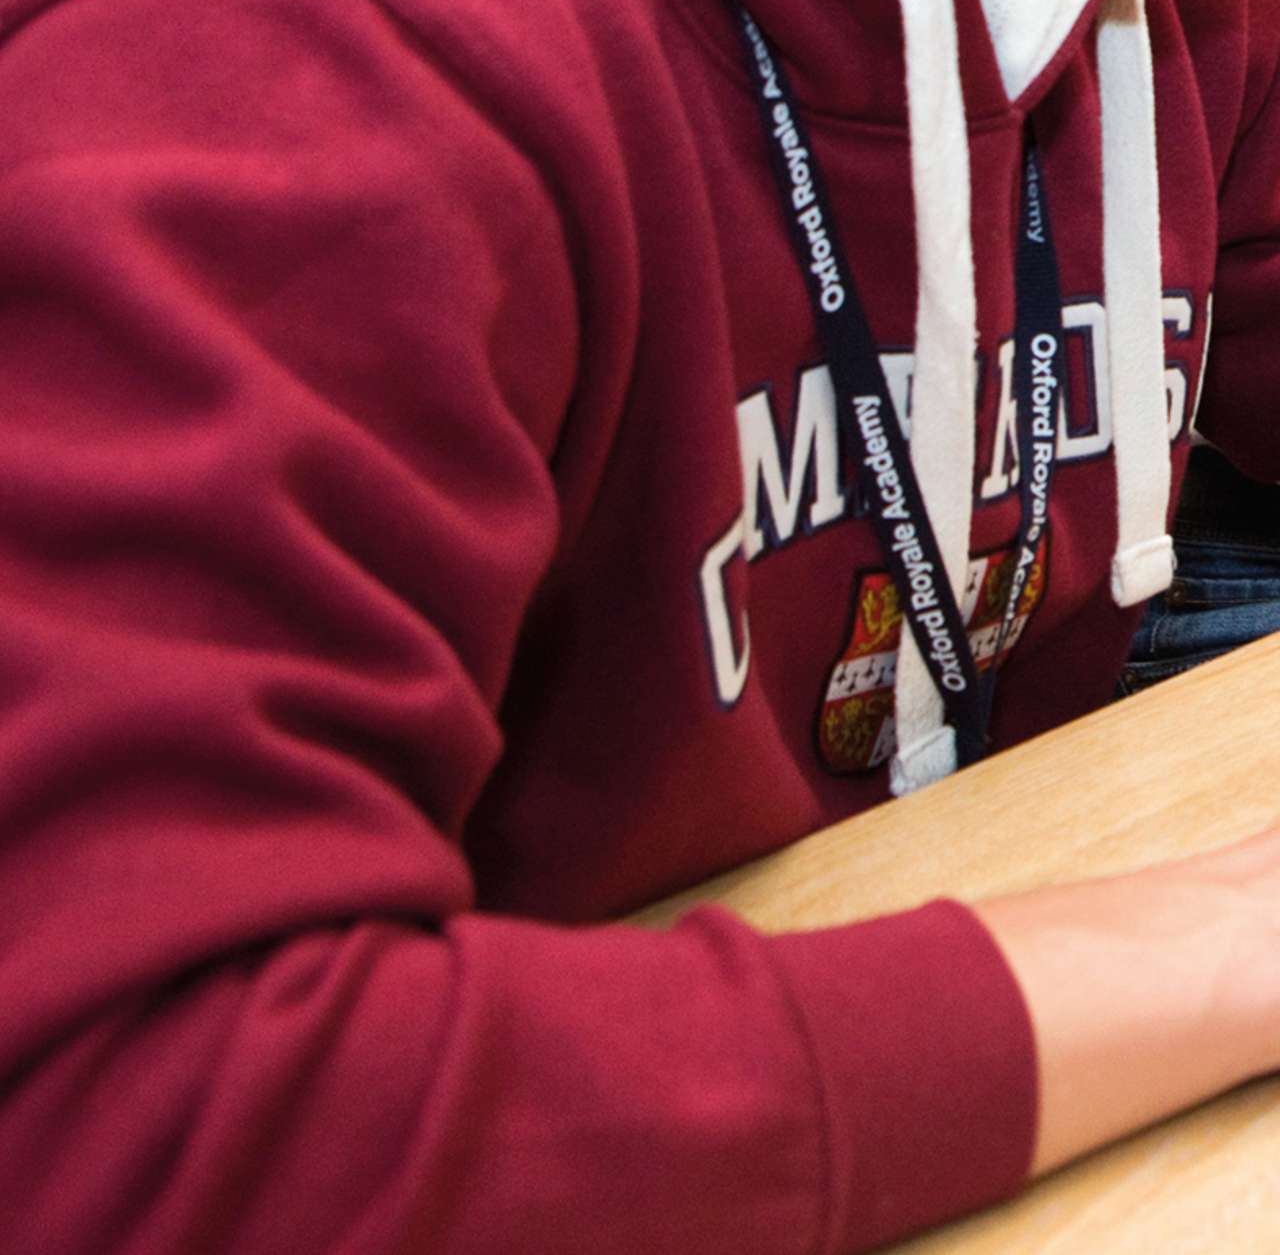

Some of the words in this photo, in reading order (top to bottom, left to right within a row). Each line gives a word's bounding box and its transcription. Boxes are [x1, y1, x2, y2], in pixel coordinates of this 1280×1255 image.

[772, 102, 816, 210] Royale
[798, 205, 845, 313] Oxford
[1030, 333, 1057, 437] Oxford
[852, 395, 911, 519] Academy
[1027, 443, 1053, 541] Royale
[892, 522, 938, 613] Royale
[916, 610, 967, 693] Oxford
